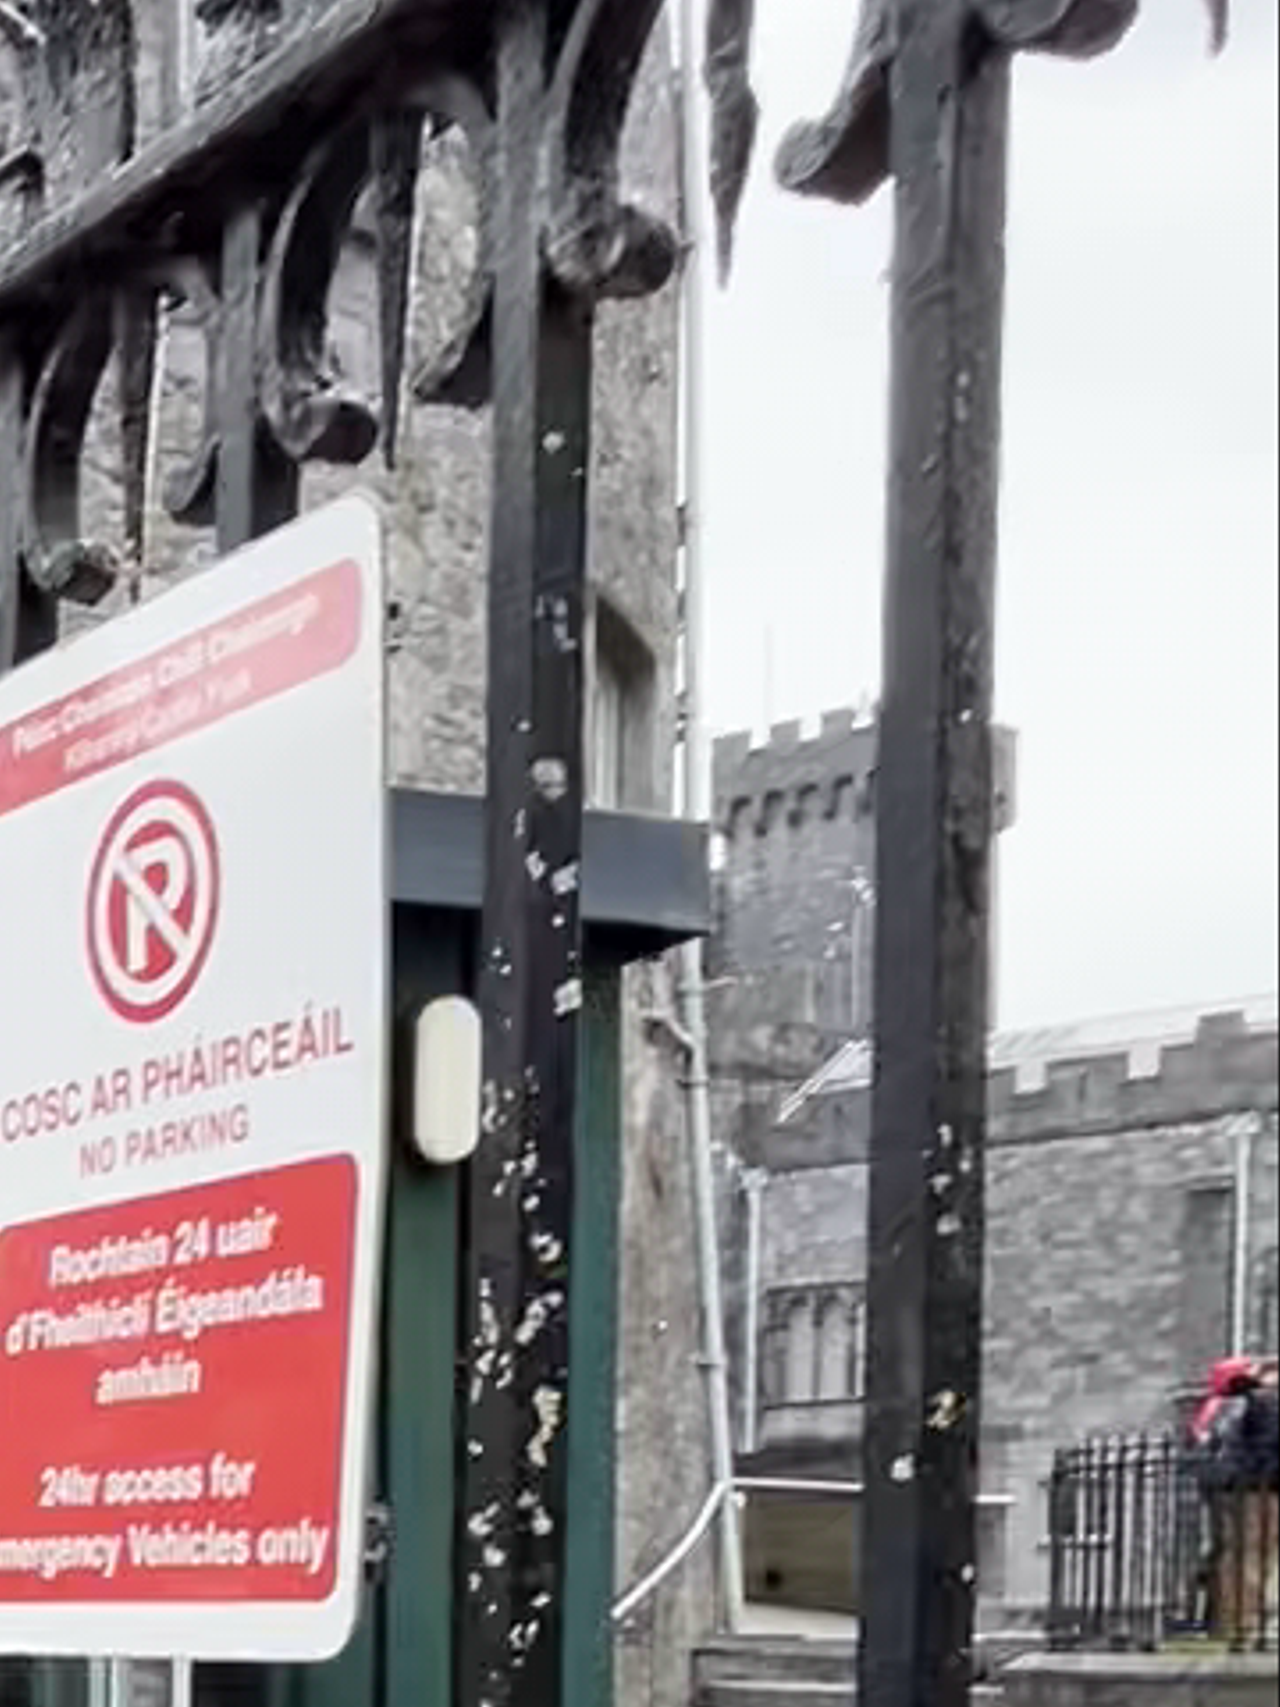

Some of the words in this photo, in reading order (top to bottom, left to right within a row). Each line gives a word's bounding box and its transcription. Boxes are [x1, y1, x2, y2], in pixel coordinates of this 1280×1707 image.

[0, 1081, 81, 1141] COSC
[90, 1068, 131, 1119] AR
[141, 999, 354, 1104] PHÁIRCEÁIL
[79, 1135, 116, 1177] NO
[125, 1104, 249, 1169] PARKING
[48, 1227, 169, 1289] Rochtain
[172, 1217, 209, 1266] 24
[216, 1206, 278, 1258] uair
[38, 1462, 100, 1507] 24hr
[103, 1461, 204, 1505] access
[210, 1450, 256, 1498] for
[126, 1520, 251, 1567] Vehicles
[256, 1516, 330, 1575] only
